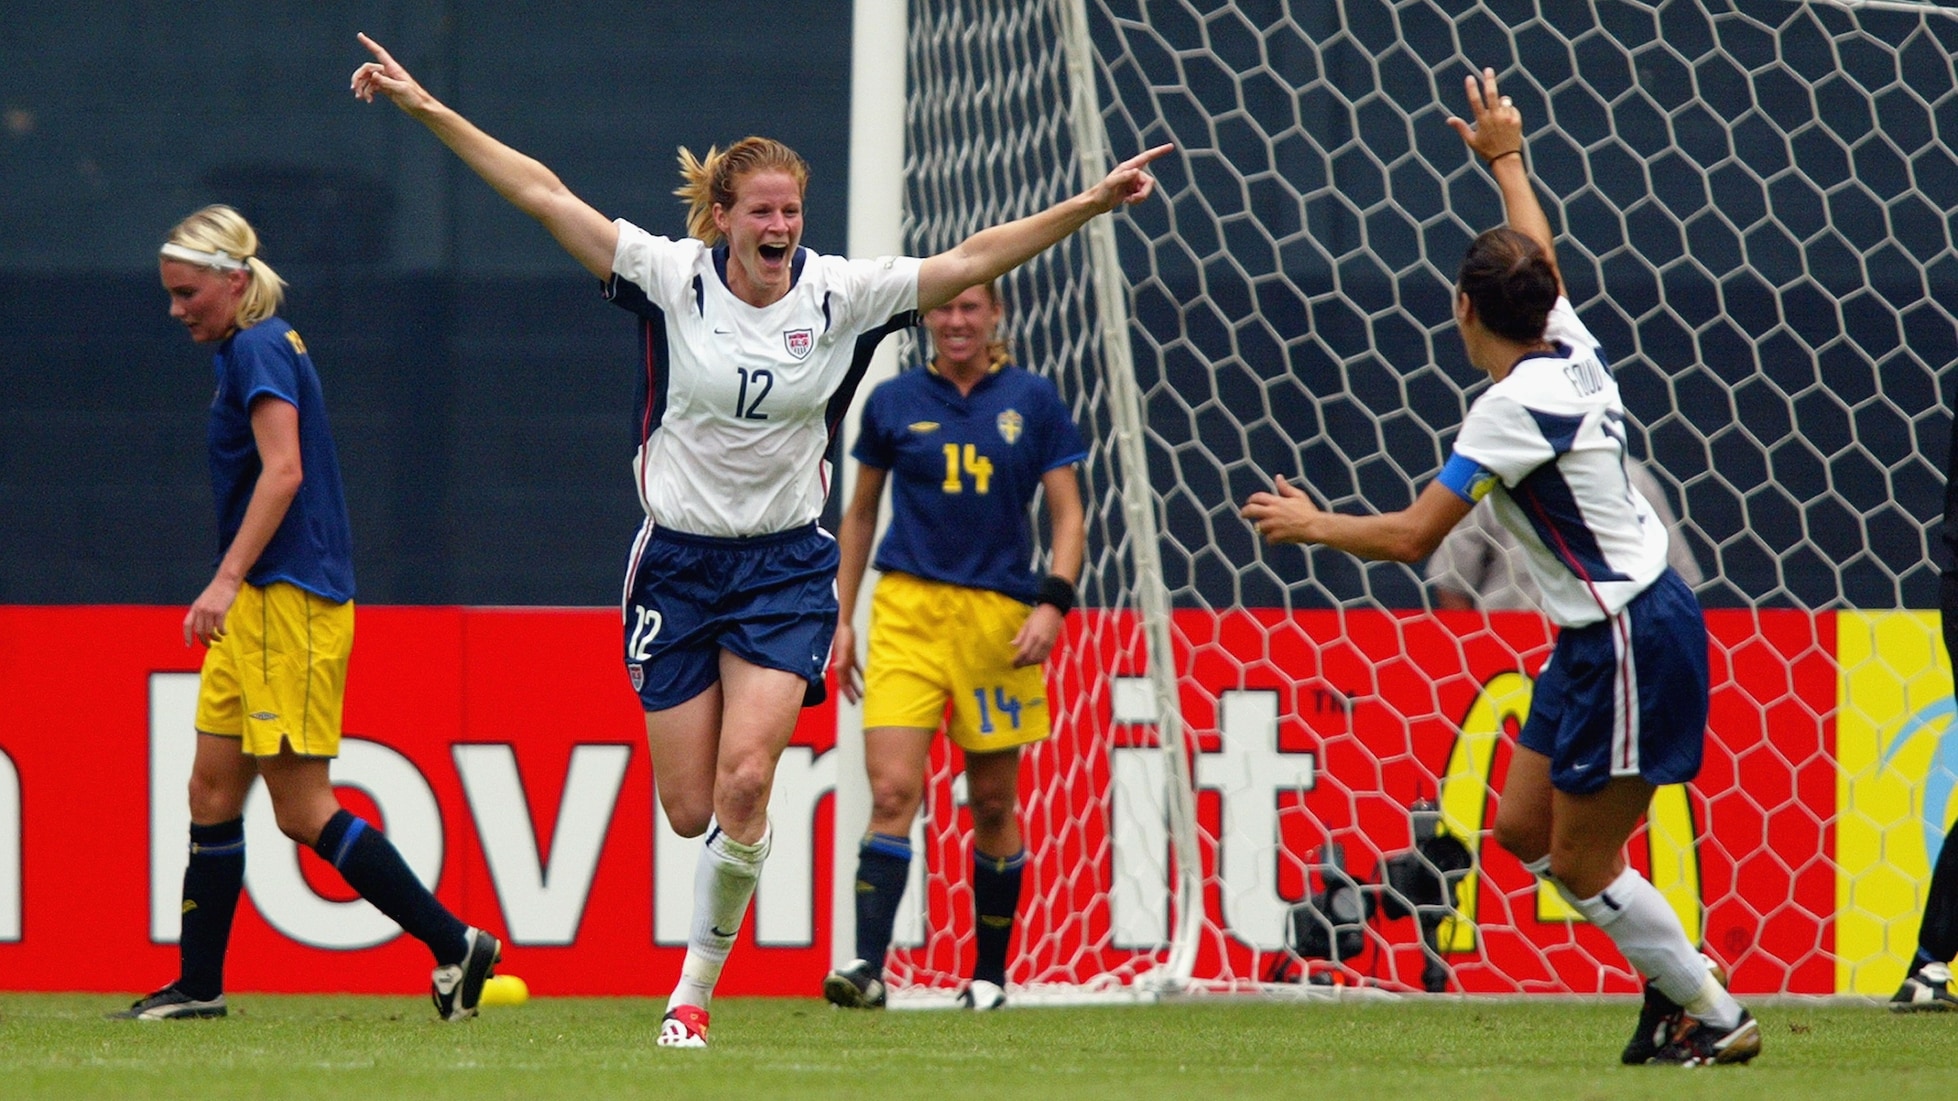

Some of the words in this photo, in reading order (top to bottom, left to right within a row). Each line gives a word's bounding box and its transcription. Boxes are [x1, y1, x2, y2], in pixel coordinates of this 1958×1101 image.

[735, 366, 774, 420] 12
[941, 442, 994, 494] 14
[628, 604, 663, 662] 12
[974, 685, 1023, 734] 14
[1110, 674, 1316, 952] it
